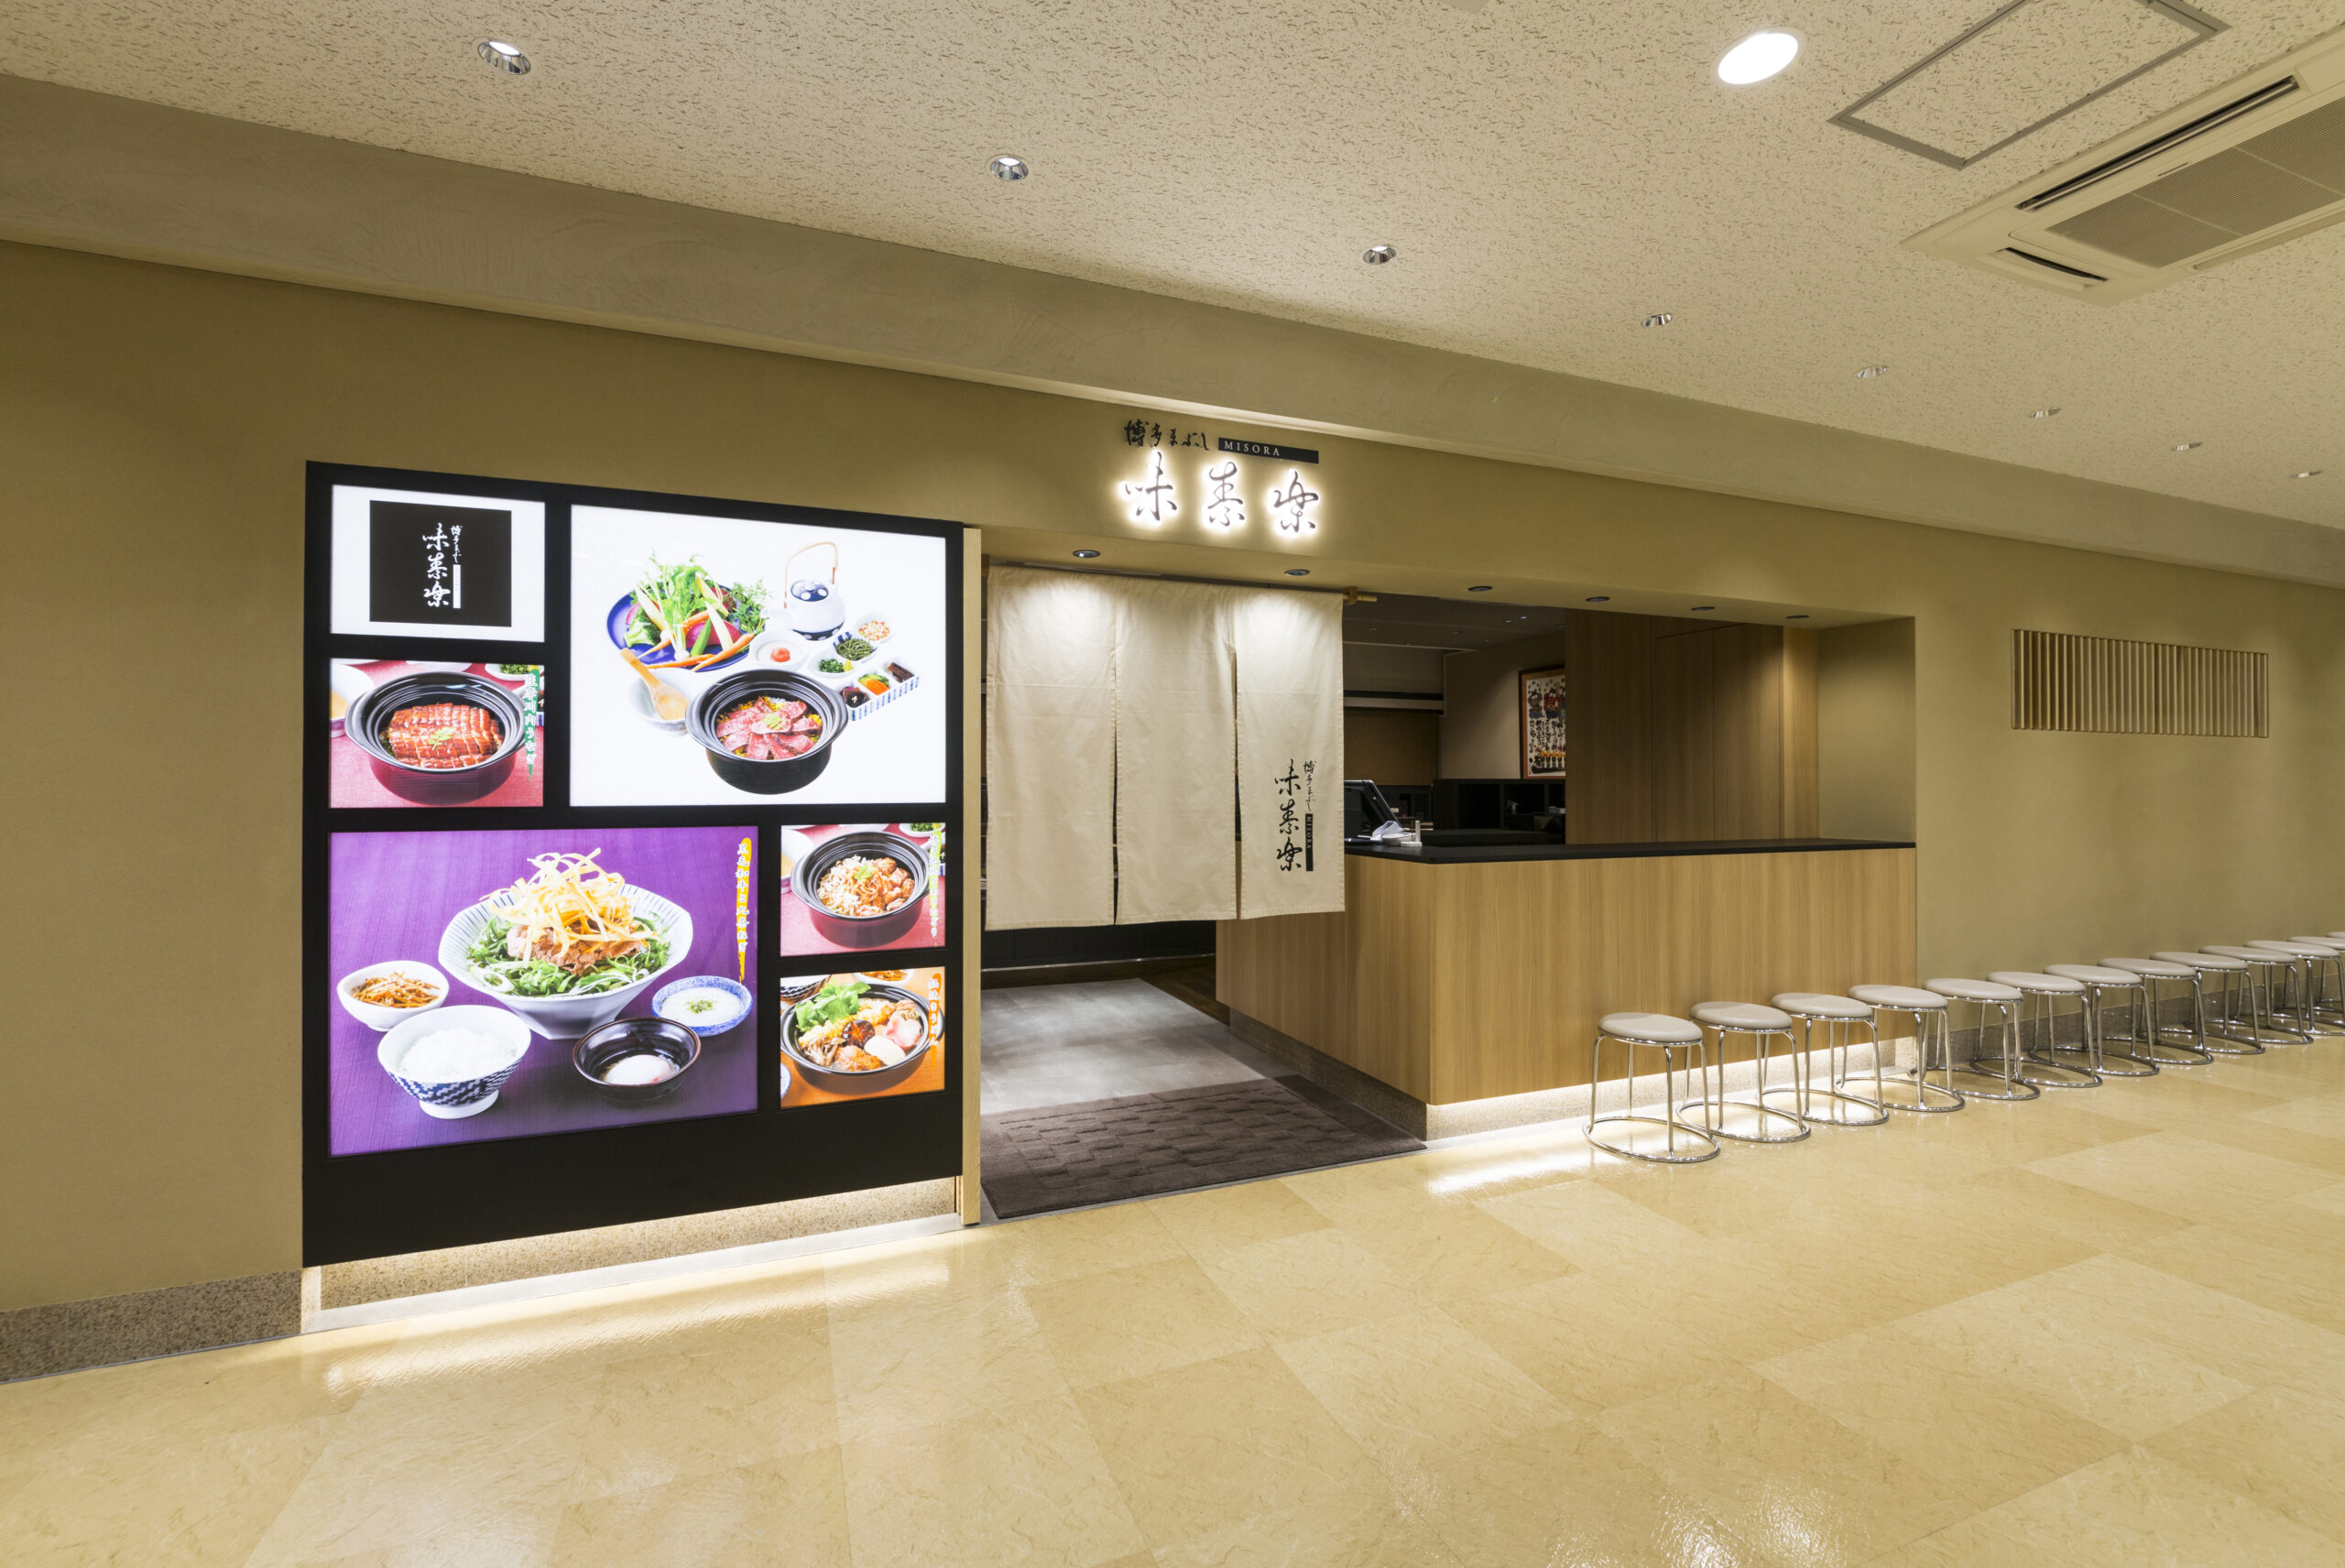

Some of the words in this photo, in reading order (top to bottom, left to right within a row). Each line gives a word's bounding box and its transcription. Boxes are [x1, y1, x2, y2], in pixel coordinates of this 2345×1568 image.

[1124, 419, 1210, 451] 博多まぶし
[1224, 442, 1281, 457] MISORA
